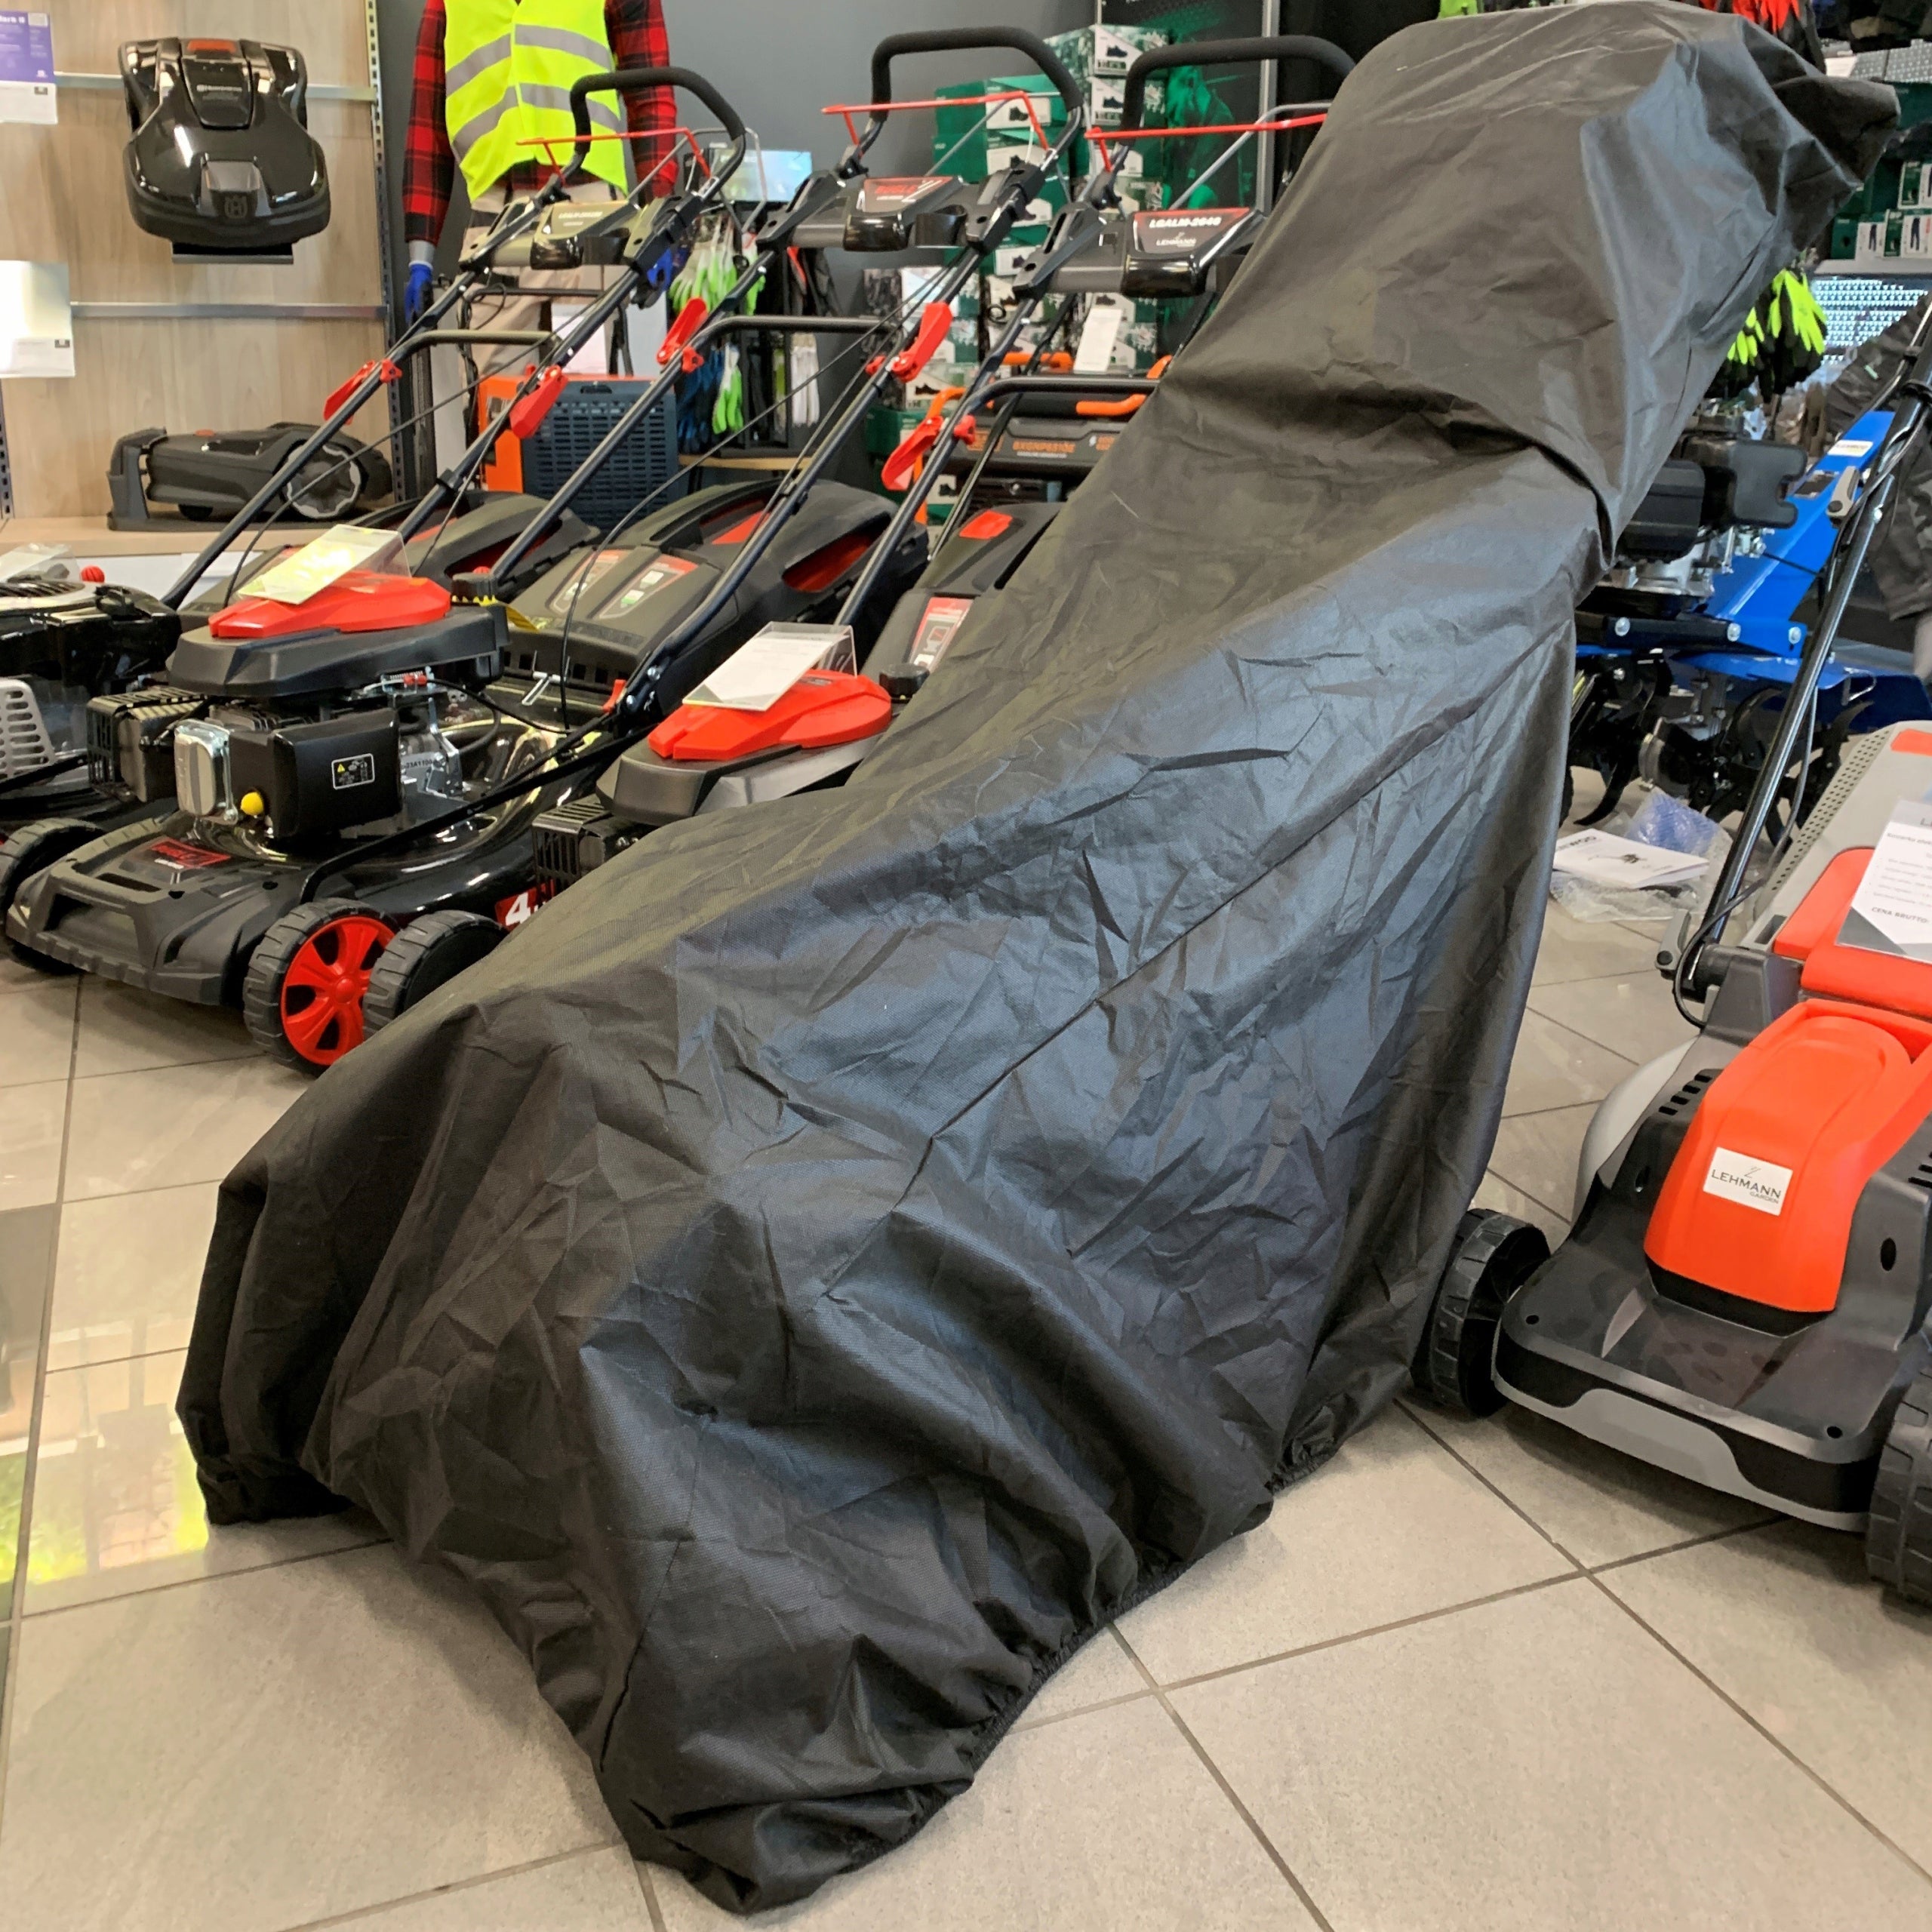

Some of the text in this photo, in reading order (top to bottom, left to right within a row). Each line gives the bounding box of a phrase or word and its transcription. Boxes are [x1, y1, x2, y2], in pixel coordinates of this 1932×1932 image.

[1872, 906, 1892, 915] CENA
[1711, 1169, 1781, 1198] LEHMANN
[1749, 1191, 1779, 1204] GARDEN
